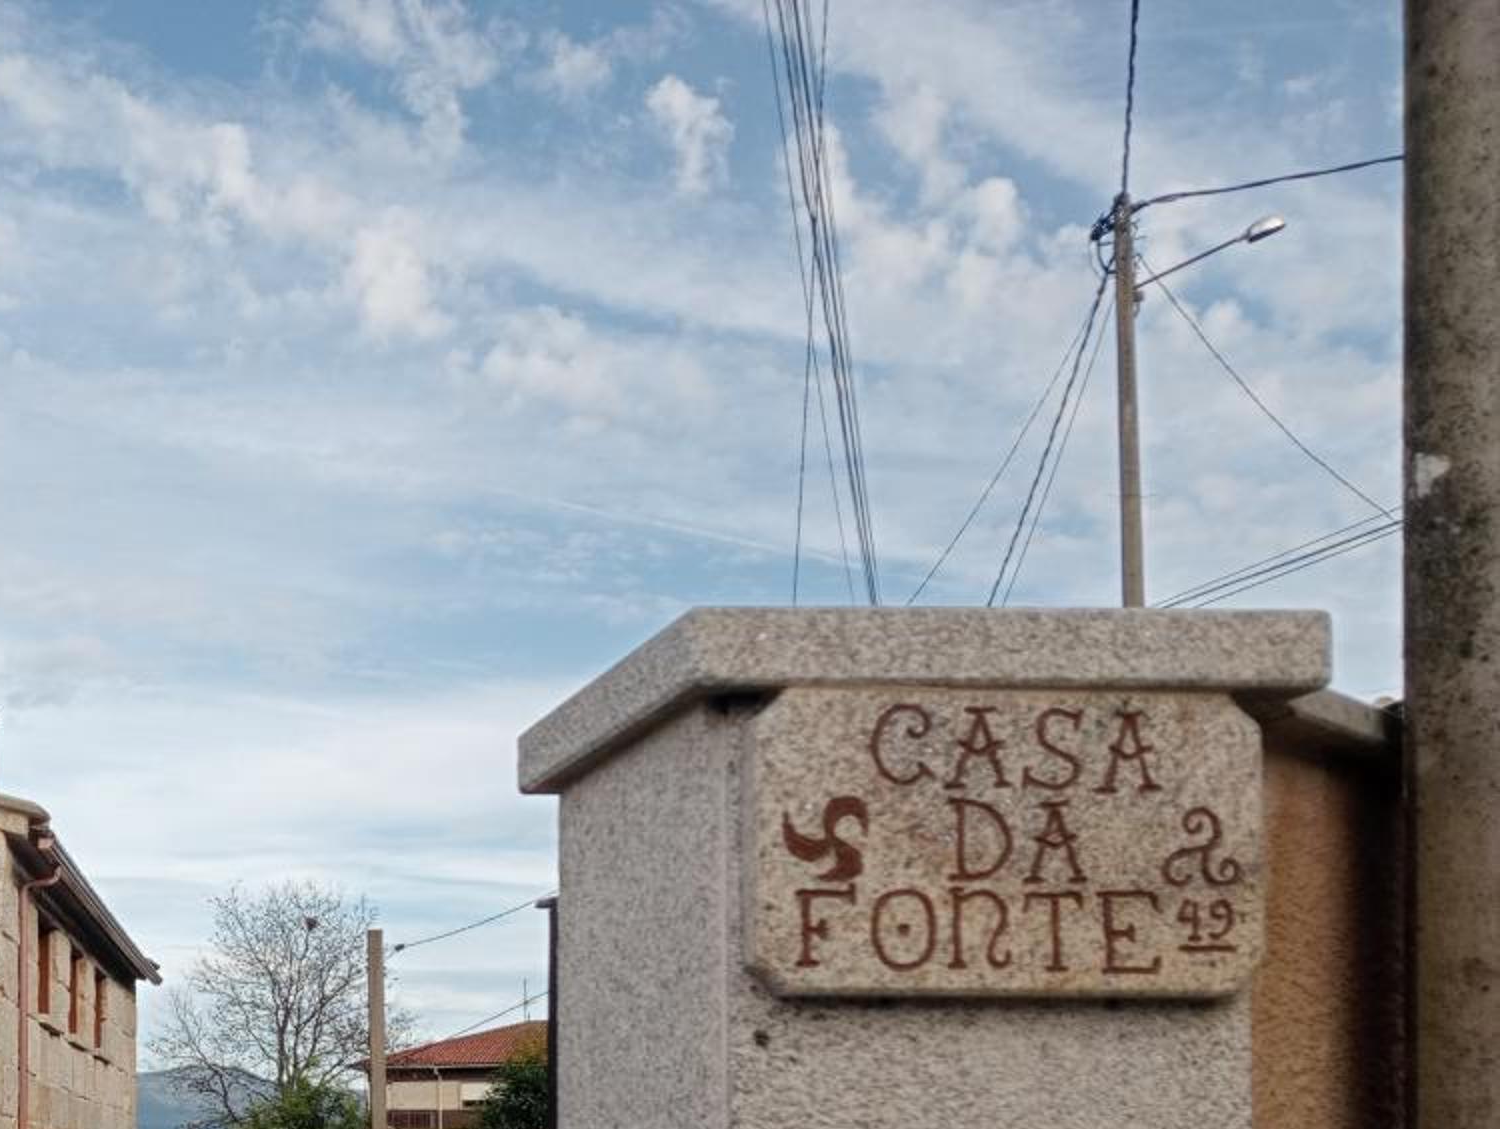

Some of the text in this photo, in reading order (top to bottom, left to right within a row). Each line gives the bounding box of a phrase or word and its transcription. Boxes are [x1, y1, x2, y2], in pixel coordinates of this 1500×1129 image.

[870, 703, 1162, 793] CASA
[947, 797, 1087, 884] DA
[795, 884, 1164, 975] FONTE
[1176, 898, 1237, 943] 49
